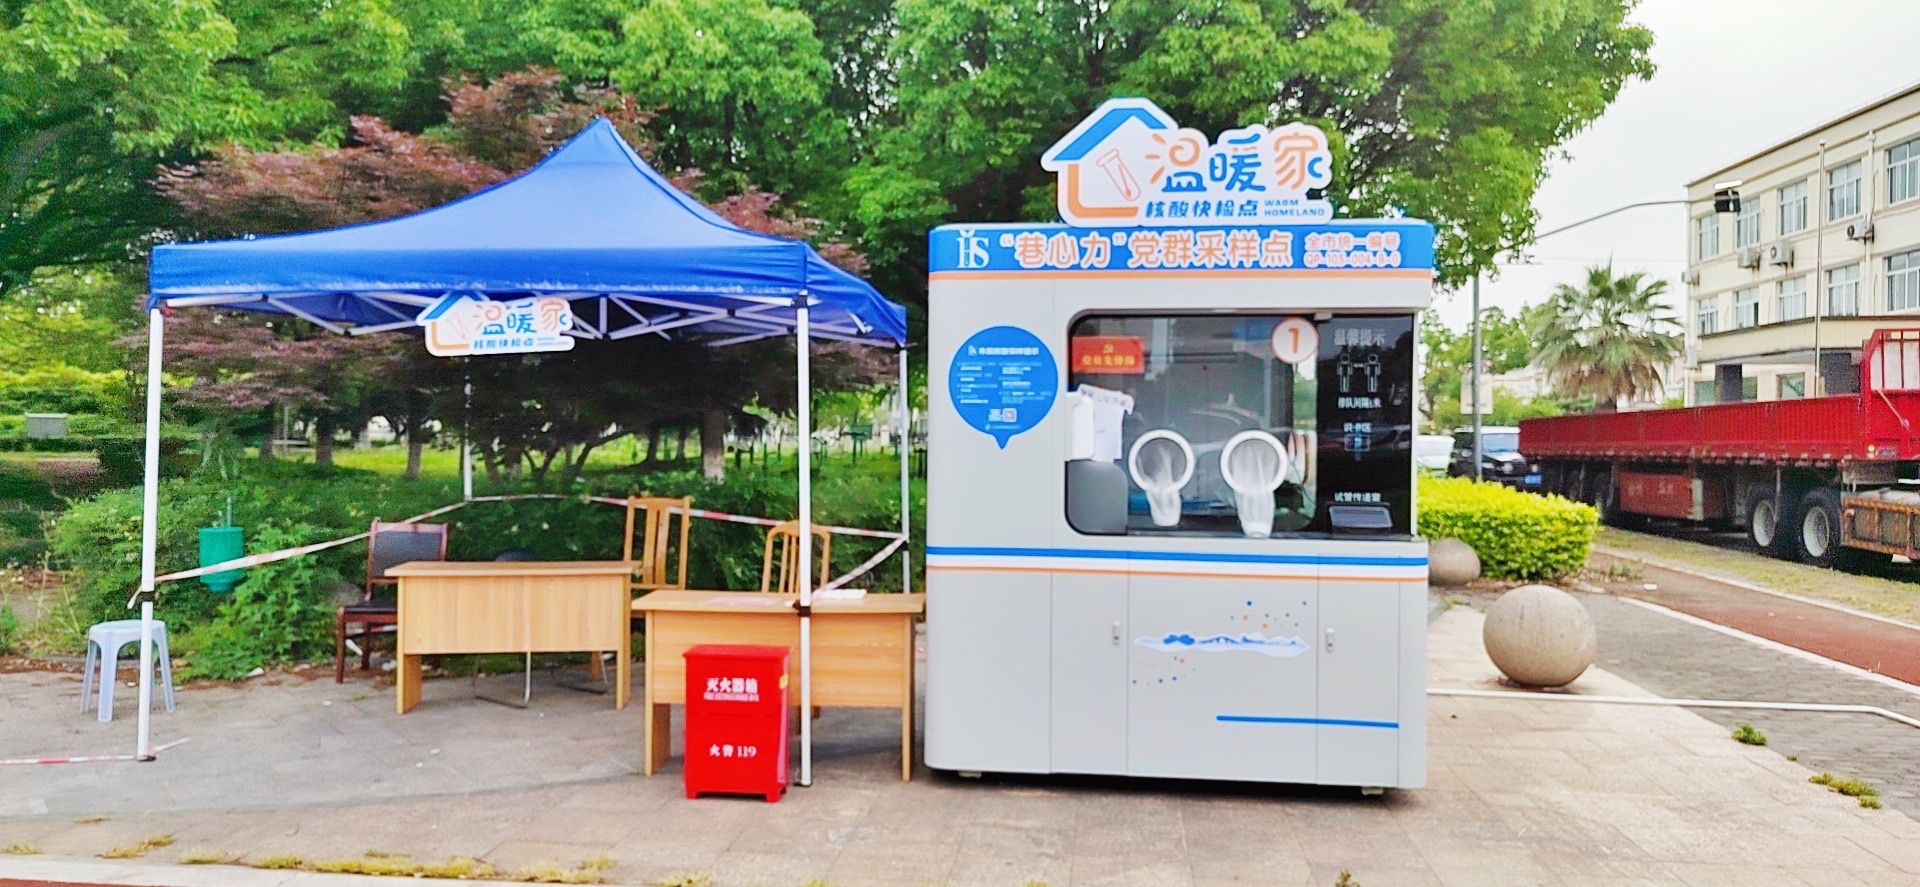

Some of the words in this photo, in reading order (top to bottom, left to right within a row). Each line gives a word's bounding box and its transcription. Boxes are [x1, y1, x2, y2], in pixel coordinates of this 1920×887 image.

[1145, 132, 1323, 192] 温暖家
[1145, 200, 1259, 218] 核酸快检点
[1264, 199, 1299, 207] WARM
[1264, 208, 1325, 217] HOMELAND
[1306, 233, 1399, 250] 全市统一编号
[473, 301, 568, 335] 温暖家
[1289, 327, 1299, 353] 1
[706, 677, 758, 693] 灭火器箱
[737, 745, 757, 758] 119
